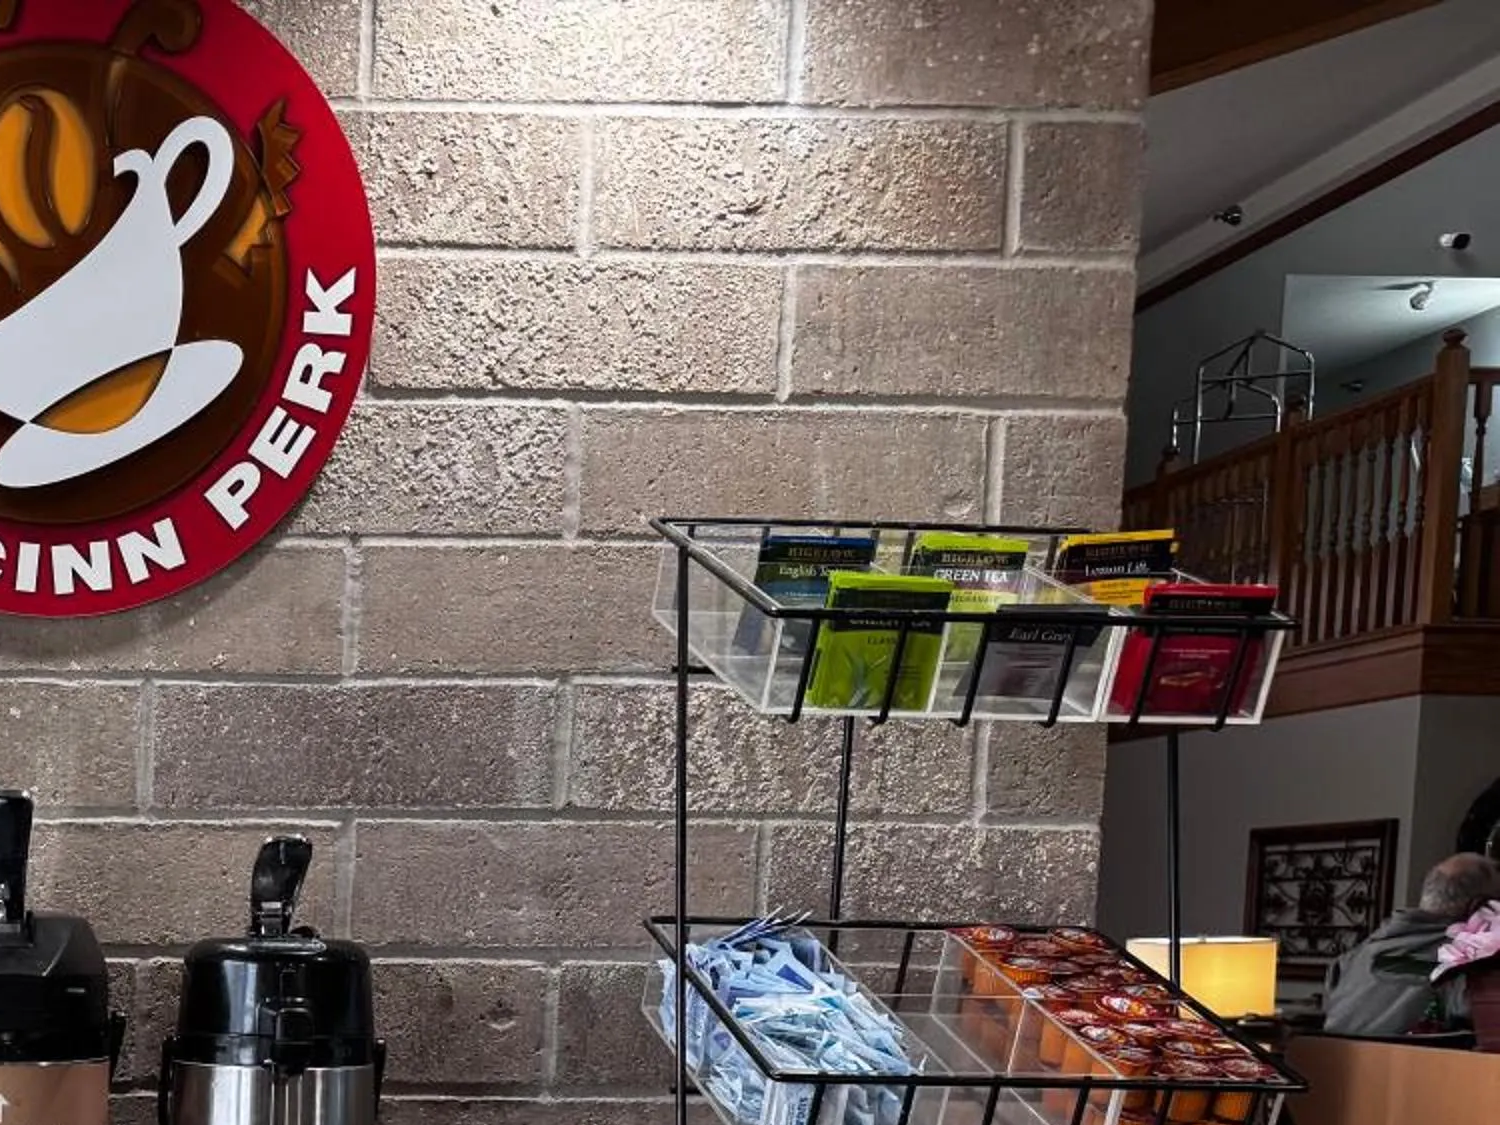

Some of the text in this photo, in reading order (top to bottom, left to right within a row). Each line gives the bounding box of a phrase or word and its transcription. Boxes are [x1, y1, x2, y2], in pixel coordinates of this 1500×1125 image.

[203, 267, 357, 530] PERK
[779, 564, 817, 578] English
[933, 568, 1009, 582] GREEN TEA
[1008, 627, 1040, 640] Earl
